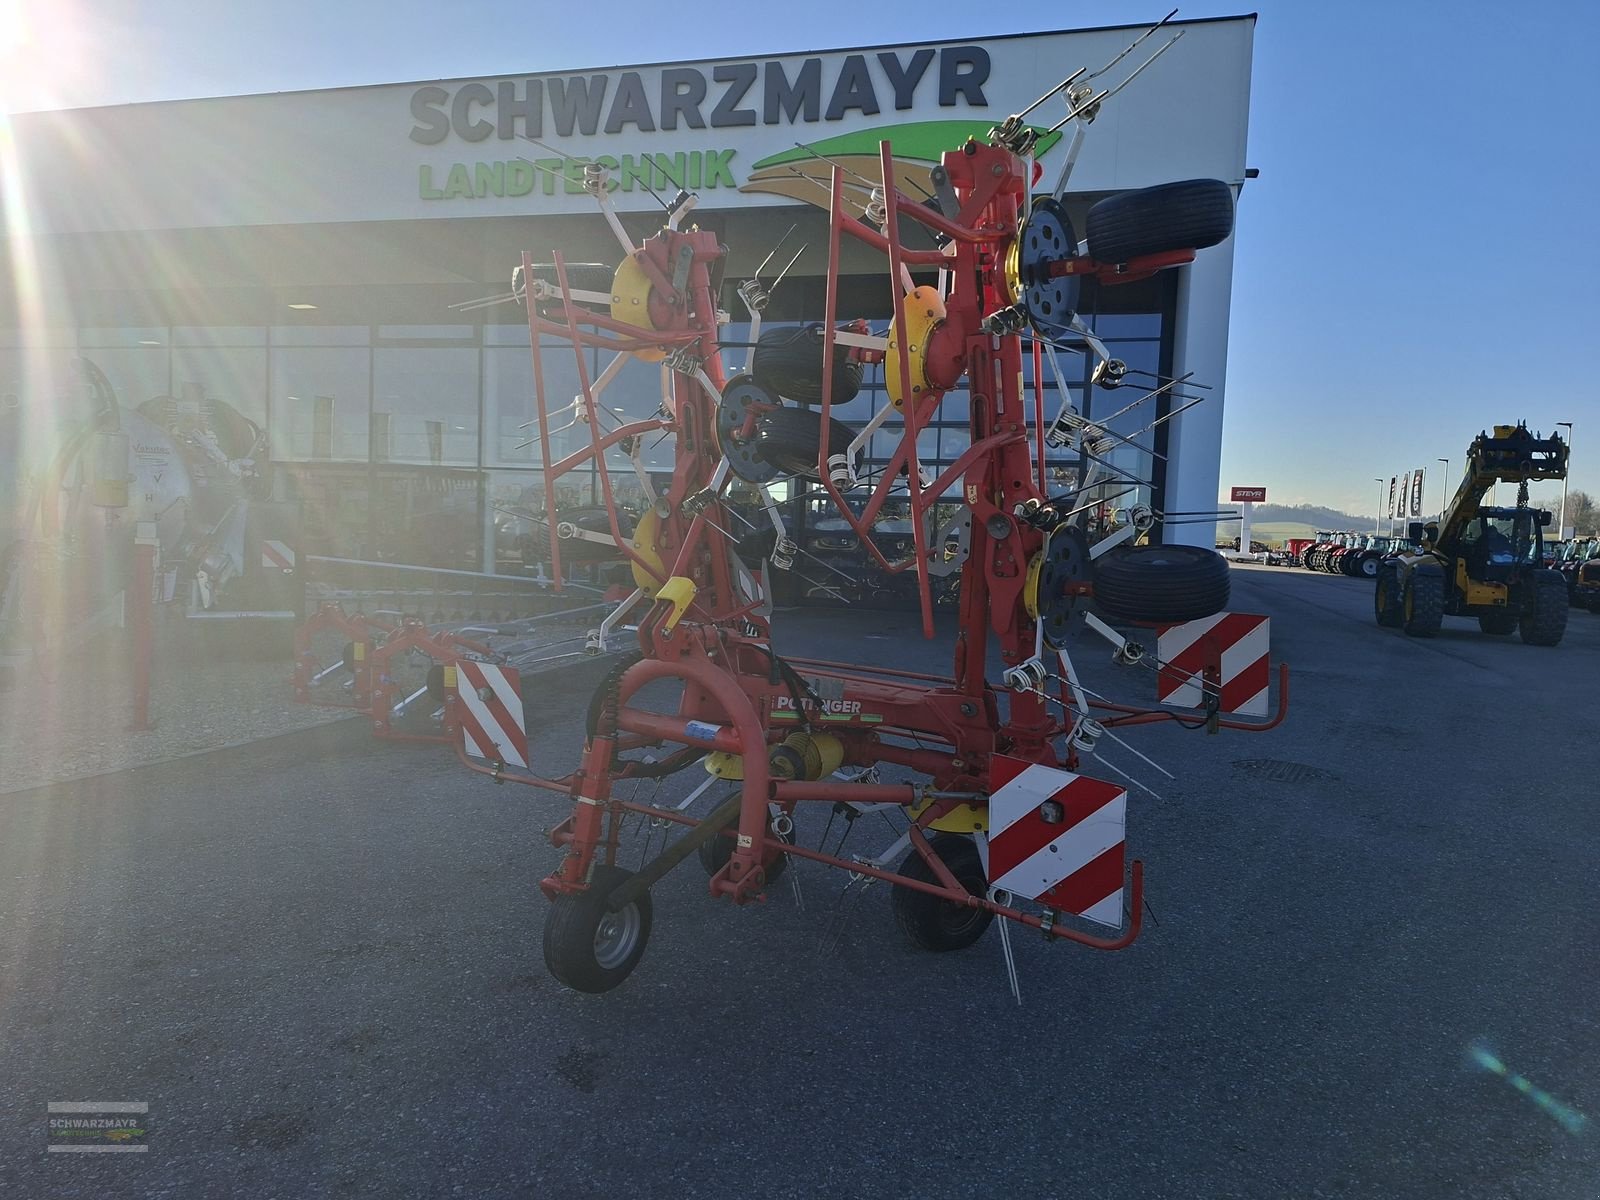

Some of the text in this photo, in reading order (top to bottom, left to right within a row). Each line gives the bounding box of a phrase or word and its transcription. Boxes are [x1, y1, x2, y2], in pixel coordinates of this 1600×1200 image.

[409, 45, 991, 145] SCHWARZMAYR
[418, 149, 738, 200] LANDTECHNIK
[777, 696, 862, 714] PTTNGER
